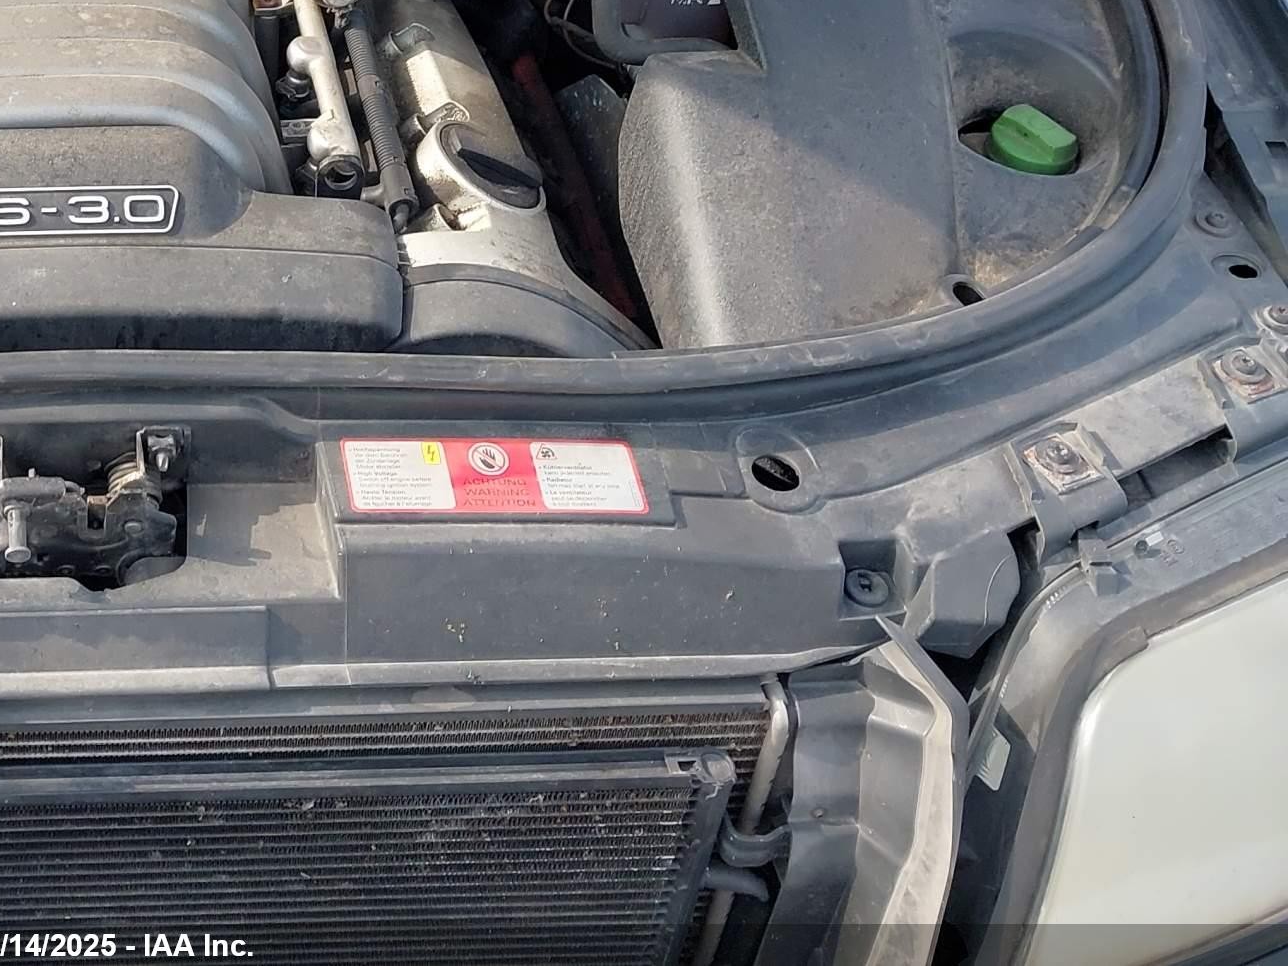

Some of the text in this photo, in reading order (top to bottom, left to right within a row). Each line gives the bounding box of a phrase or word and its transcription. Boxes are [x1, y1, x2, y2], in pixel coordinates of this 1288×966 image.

[463, 477, 527, 486] ACHTUNG
[463, 488, 530, 496] WARNING
[463, 498, 536, 507] ATTENTION
